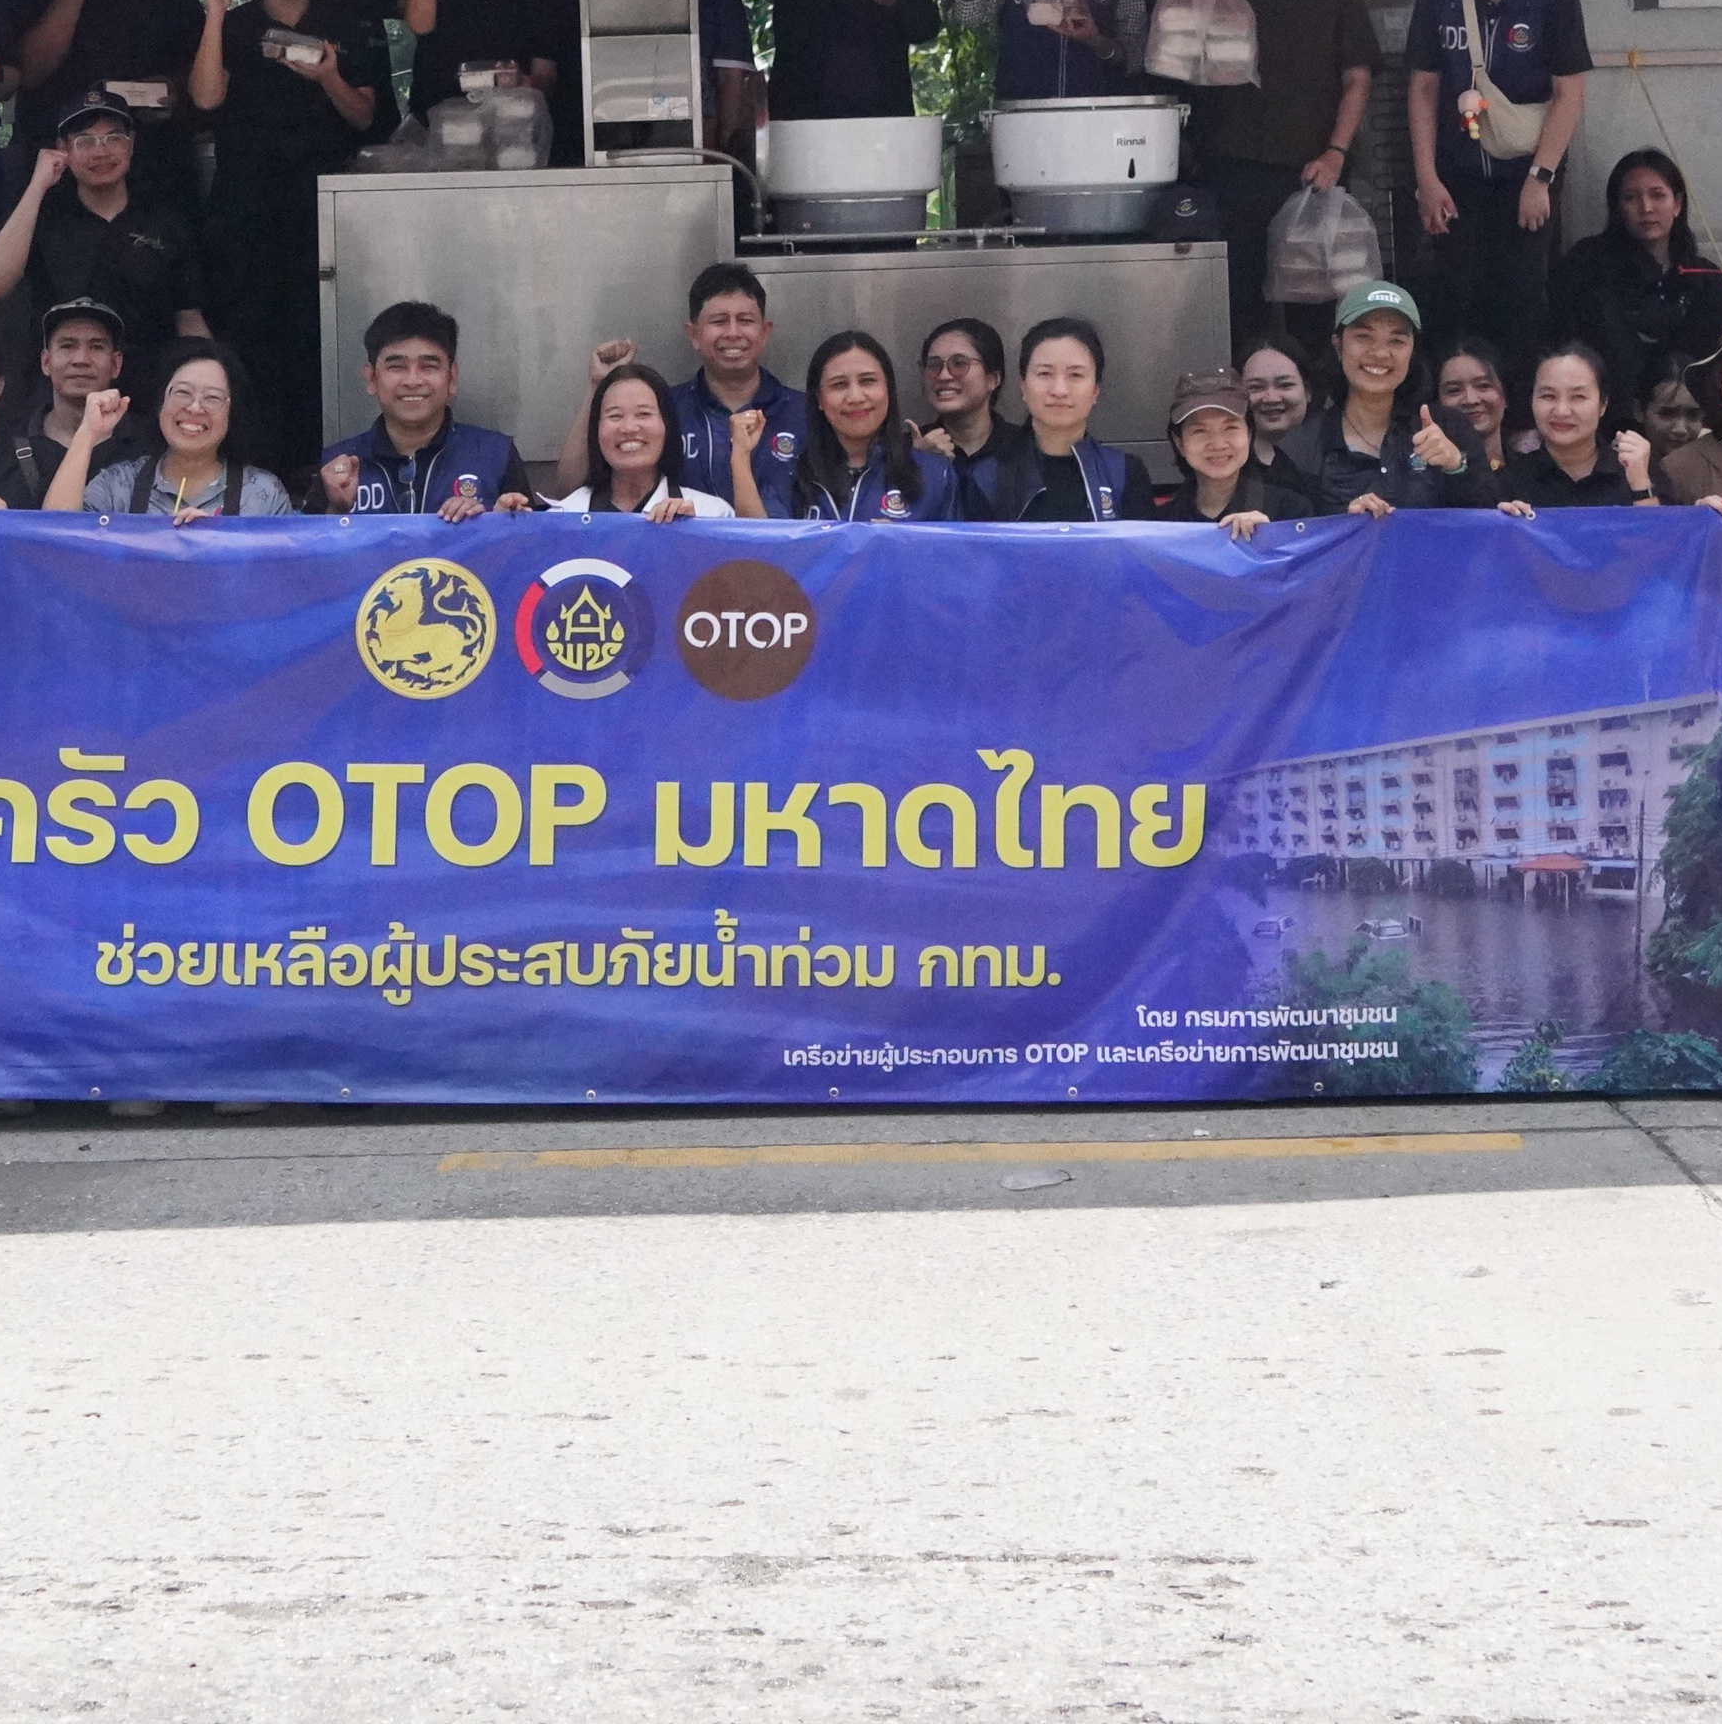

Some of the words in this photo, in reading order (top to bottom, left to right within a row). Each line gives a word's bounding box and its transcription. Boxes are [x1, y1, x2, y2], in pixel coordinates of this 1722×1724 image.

[1116, 136, 1146, 147] Rinnai
[349, 482, 386, 513] DD
[683, 611, 809, 649] OTOP
[247, 762, 607, 867] OTOP
[655, 749, 1207, 868] มหาดไทย
[96, 909, 895, 1005] ช่วยเหลือผู้ประสบภัยน้ำท่วม
[918, 944, 1061, 988] กทม.
[1136, 1004, 1178, 1028] โดย
[1184, 1004, 1397, 1030] กรมการพัฒนาชุมชน
[783, 1042, 1018, 1072] เครือข่ายผู้ประกอบการ
[1025, 1043, 1089, 1064] OTOP
[1096, 1038, 1398, 1065] และเครือข่ายการพัฒนาชุมชน
